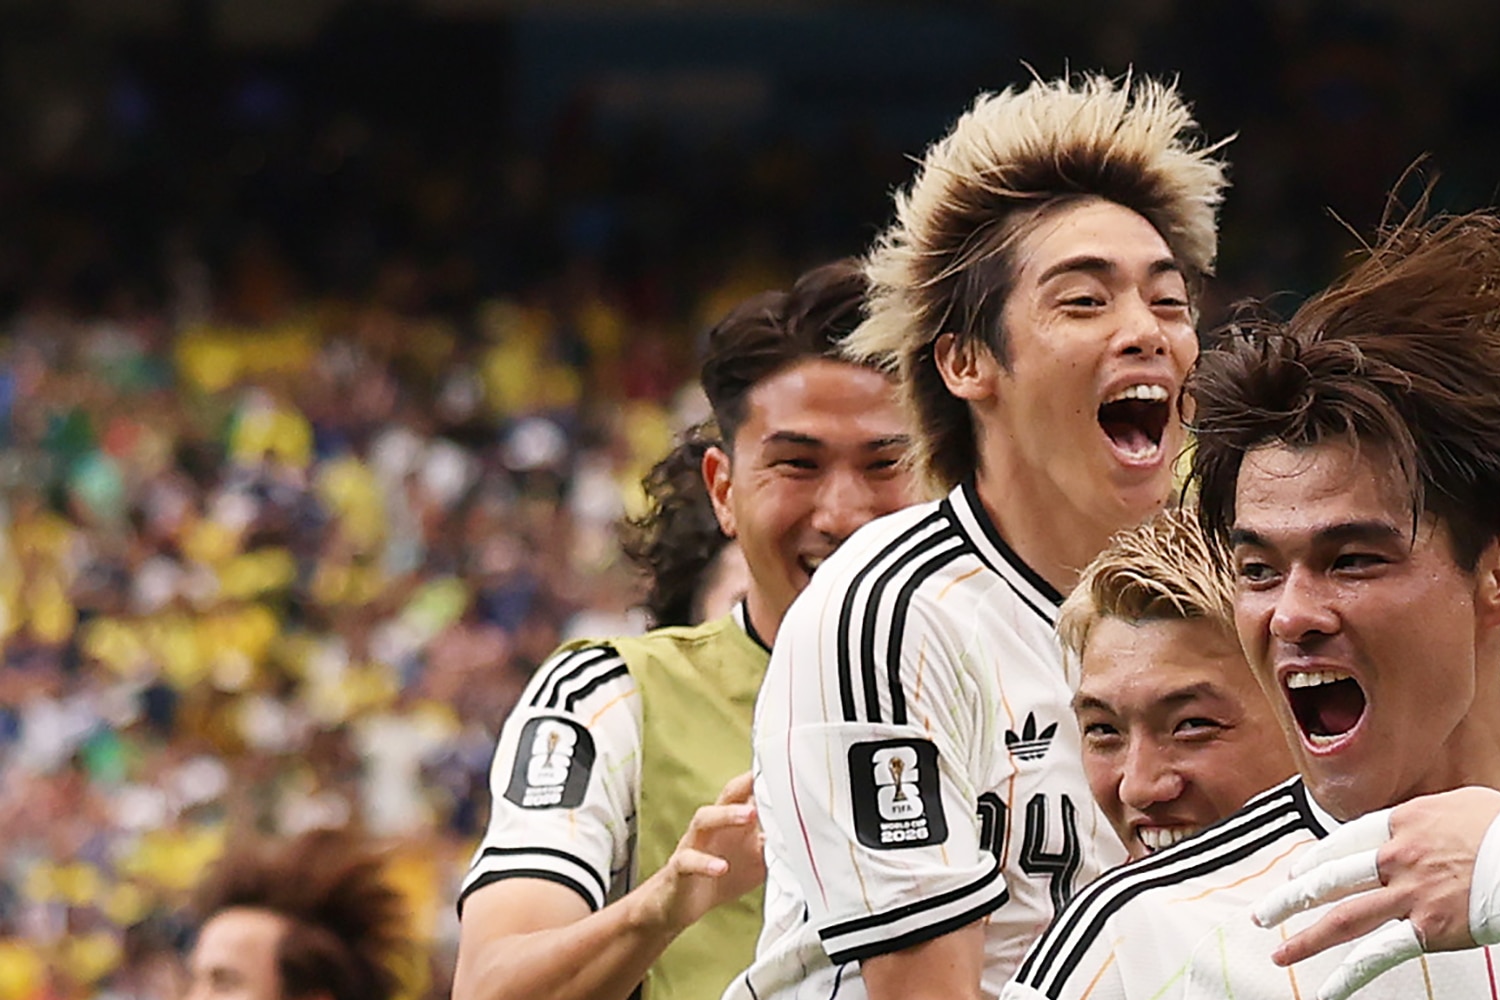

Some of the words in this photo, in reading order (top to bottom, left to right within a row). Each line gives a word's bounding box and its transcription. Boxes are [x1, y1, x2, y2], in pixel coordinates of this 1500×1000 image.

[892, 804, 912, 814] FIFA
[881, 827, 929, 843] 2026
[977, 792, 1084, 918] 14
